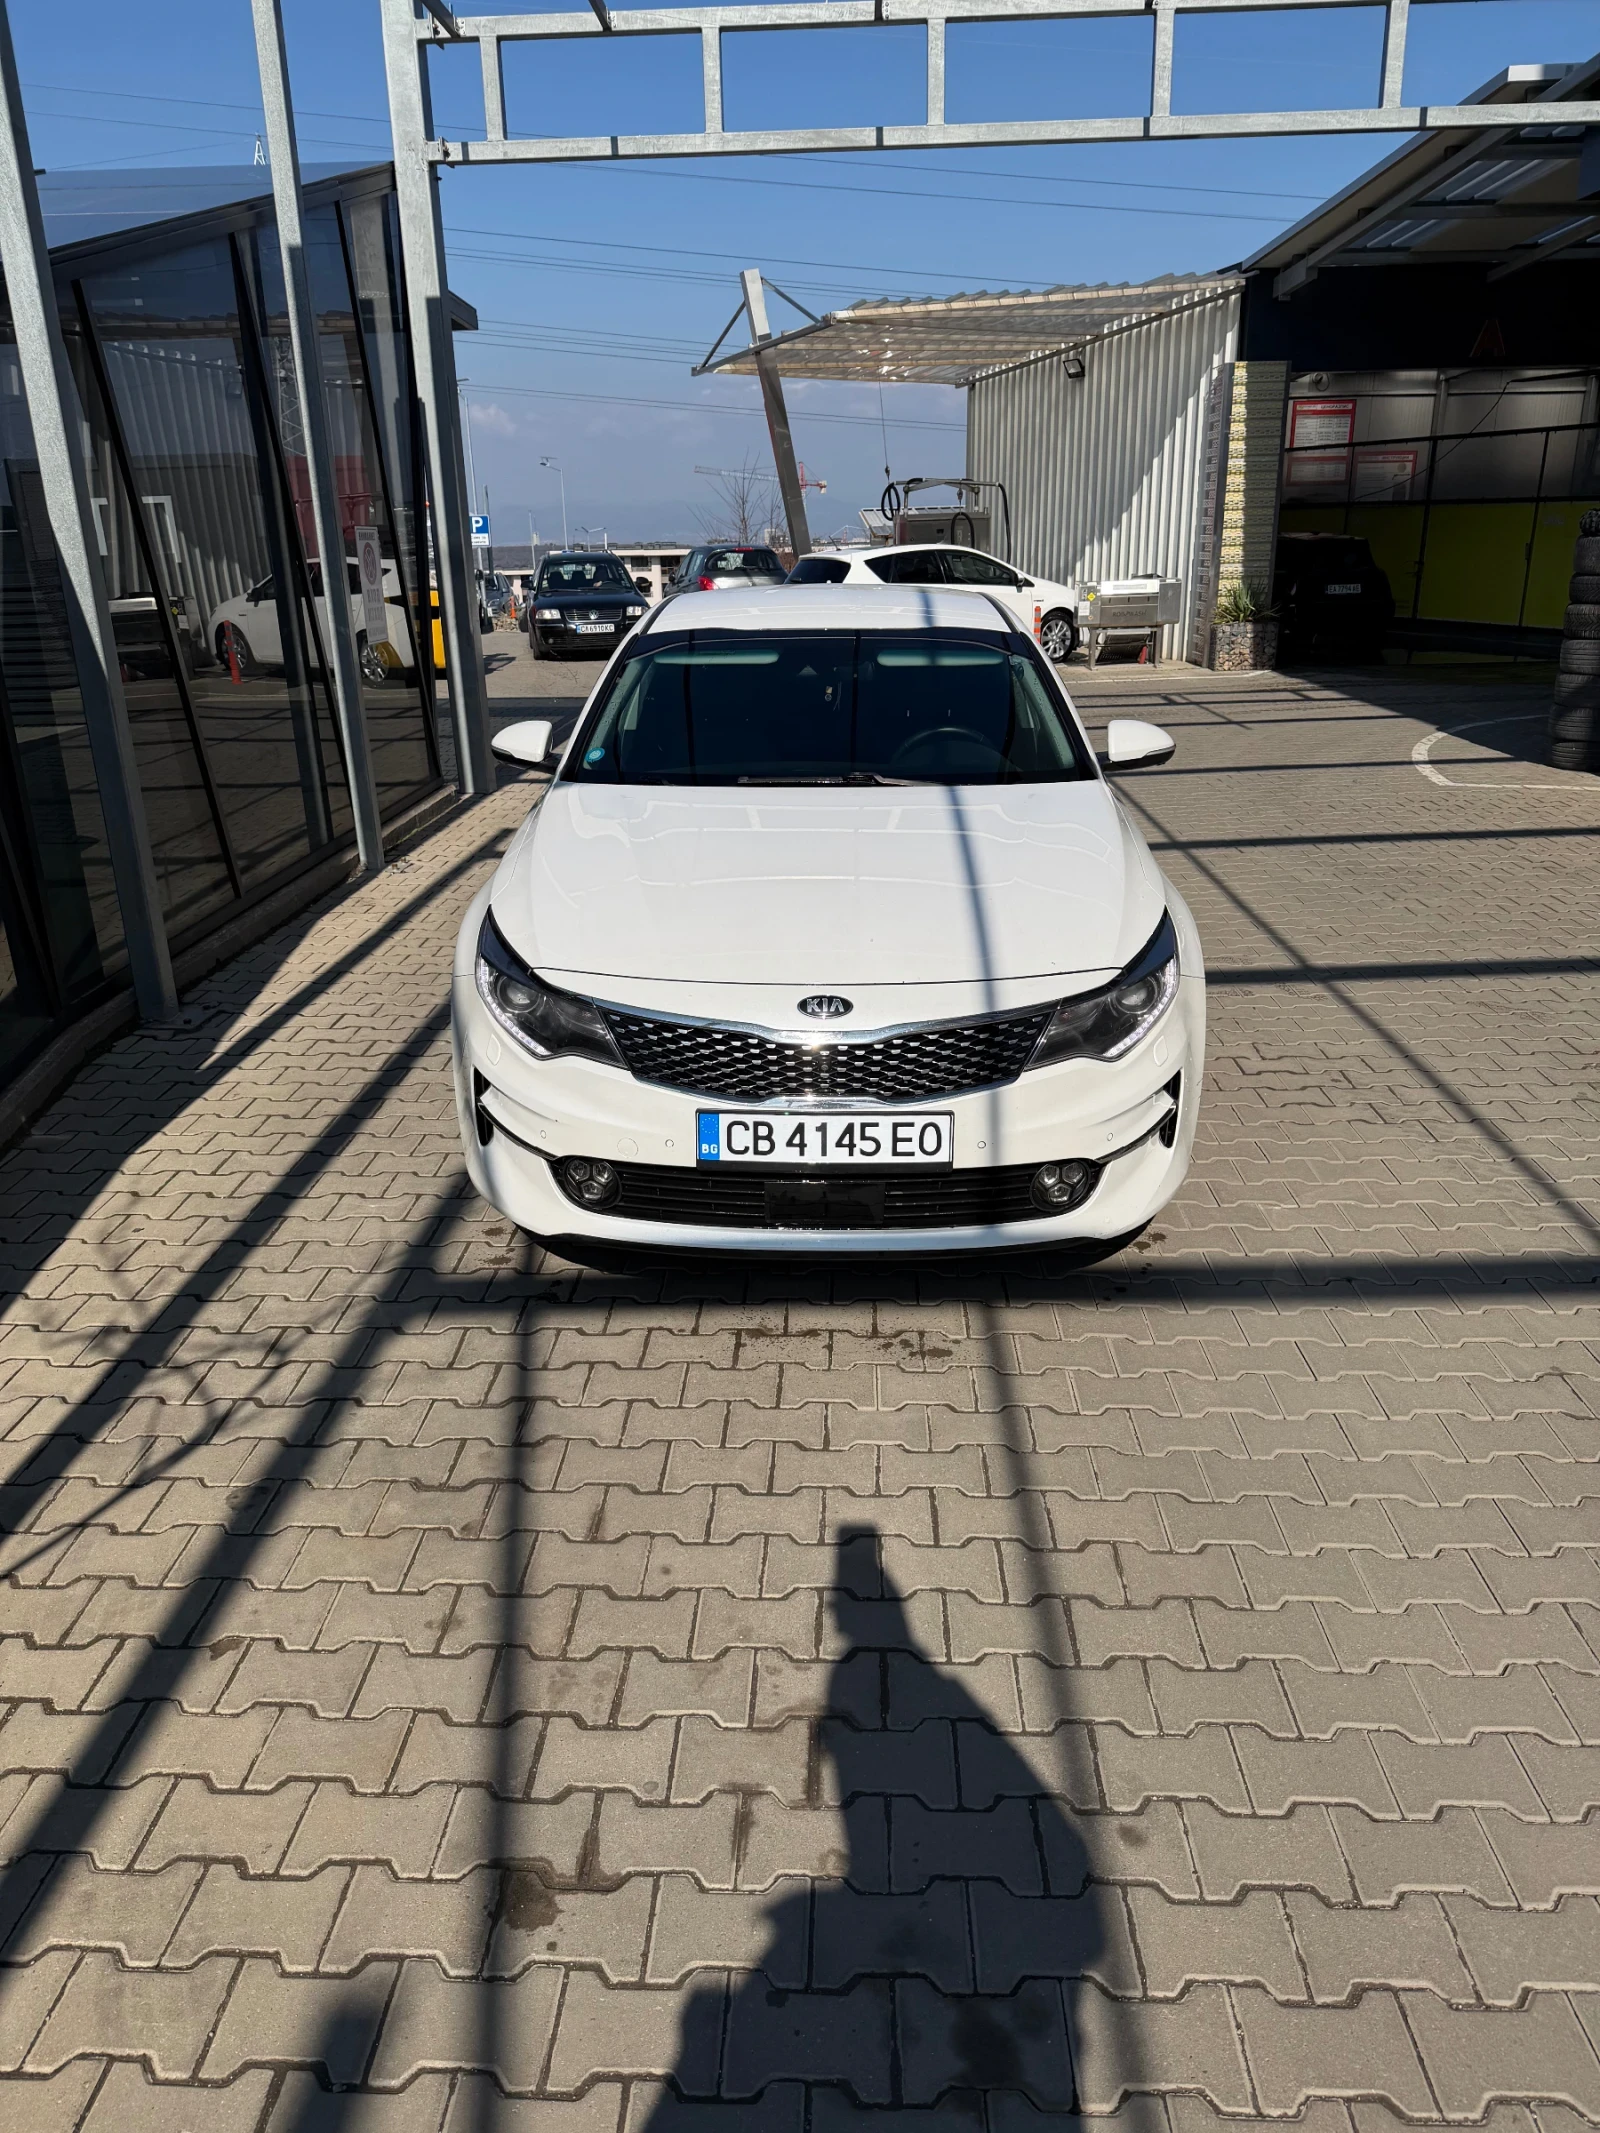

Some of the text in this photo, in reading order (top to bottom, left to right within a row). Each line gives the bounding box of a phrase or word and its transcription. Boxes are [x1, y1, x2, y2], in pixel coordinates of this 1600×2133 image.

[471, 516, 484, 533] P
[806, 998, 845, 1013] KIA
[726, 1120, 776, 1156] CB
[785, 1121, 882, 1157] 4145
[701, 1144, 718, 1154] BG
